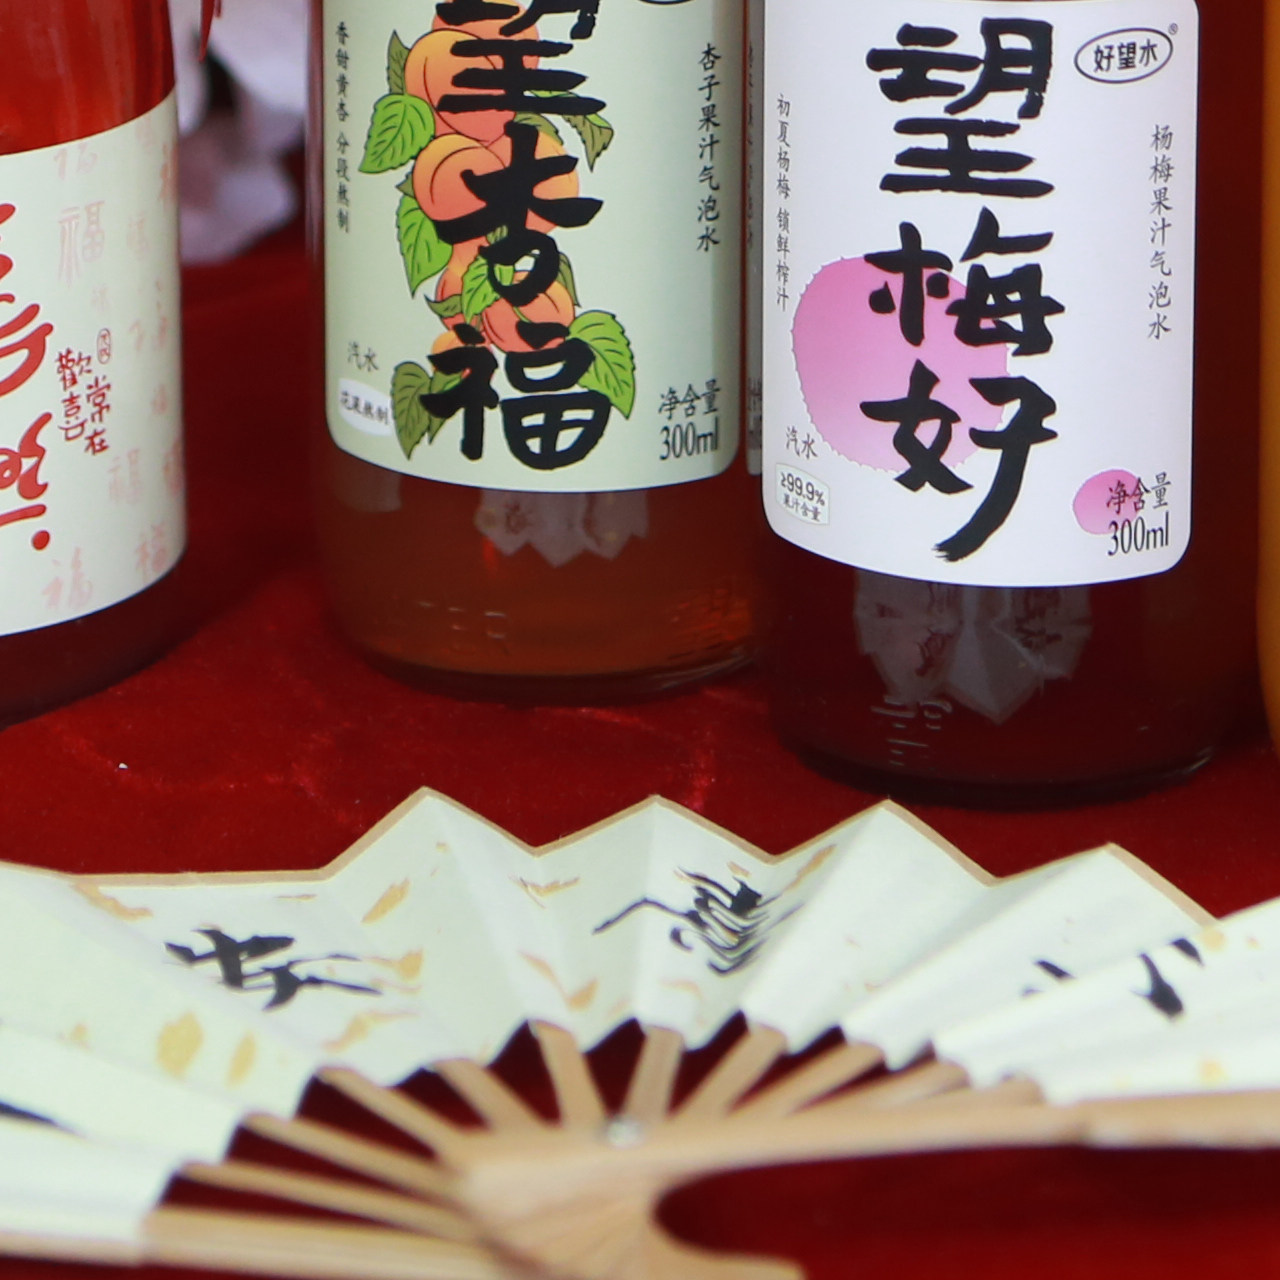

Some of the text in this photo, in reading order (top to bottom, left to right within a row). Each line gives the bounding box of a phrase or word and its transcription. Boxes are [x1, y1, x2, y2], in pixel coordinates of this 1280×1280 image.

[1093, 42, 1158, 74] 好望水
[696, 42, 721, 252] 杏子果汁气泡水
[1147, 124, 1175, 341] 杨梅果汁气泡水
[859, 17, 1066, 563] 望梅好
[347, 341, 379, 372] 汽水
[658, 383, 720, 421] 净含量
[659, 421, 719, 461] 300ml
[786, 426, 818, 459] 汽水
[1106, 471, 1169, 511] 净含量
[1107, 513, 1169, 557] 300ml
